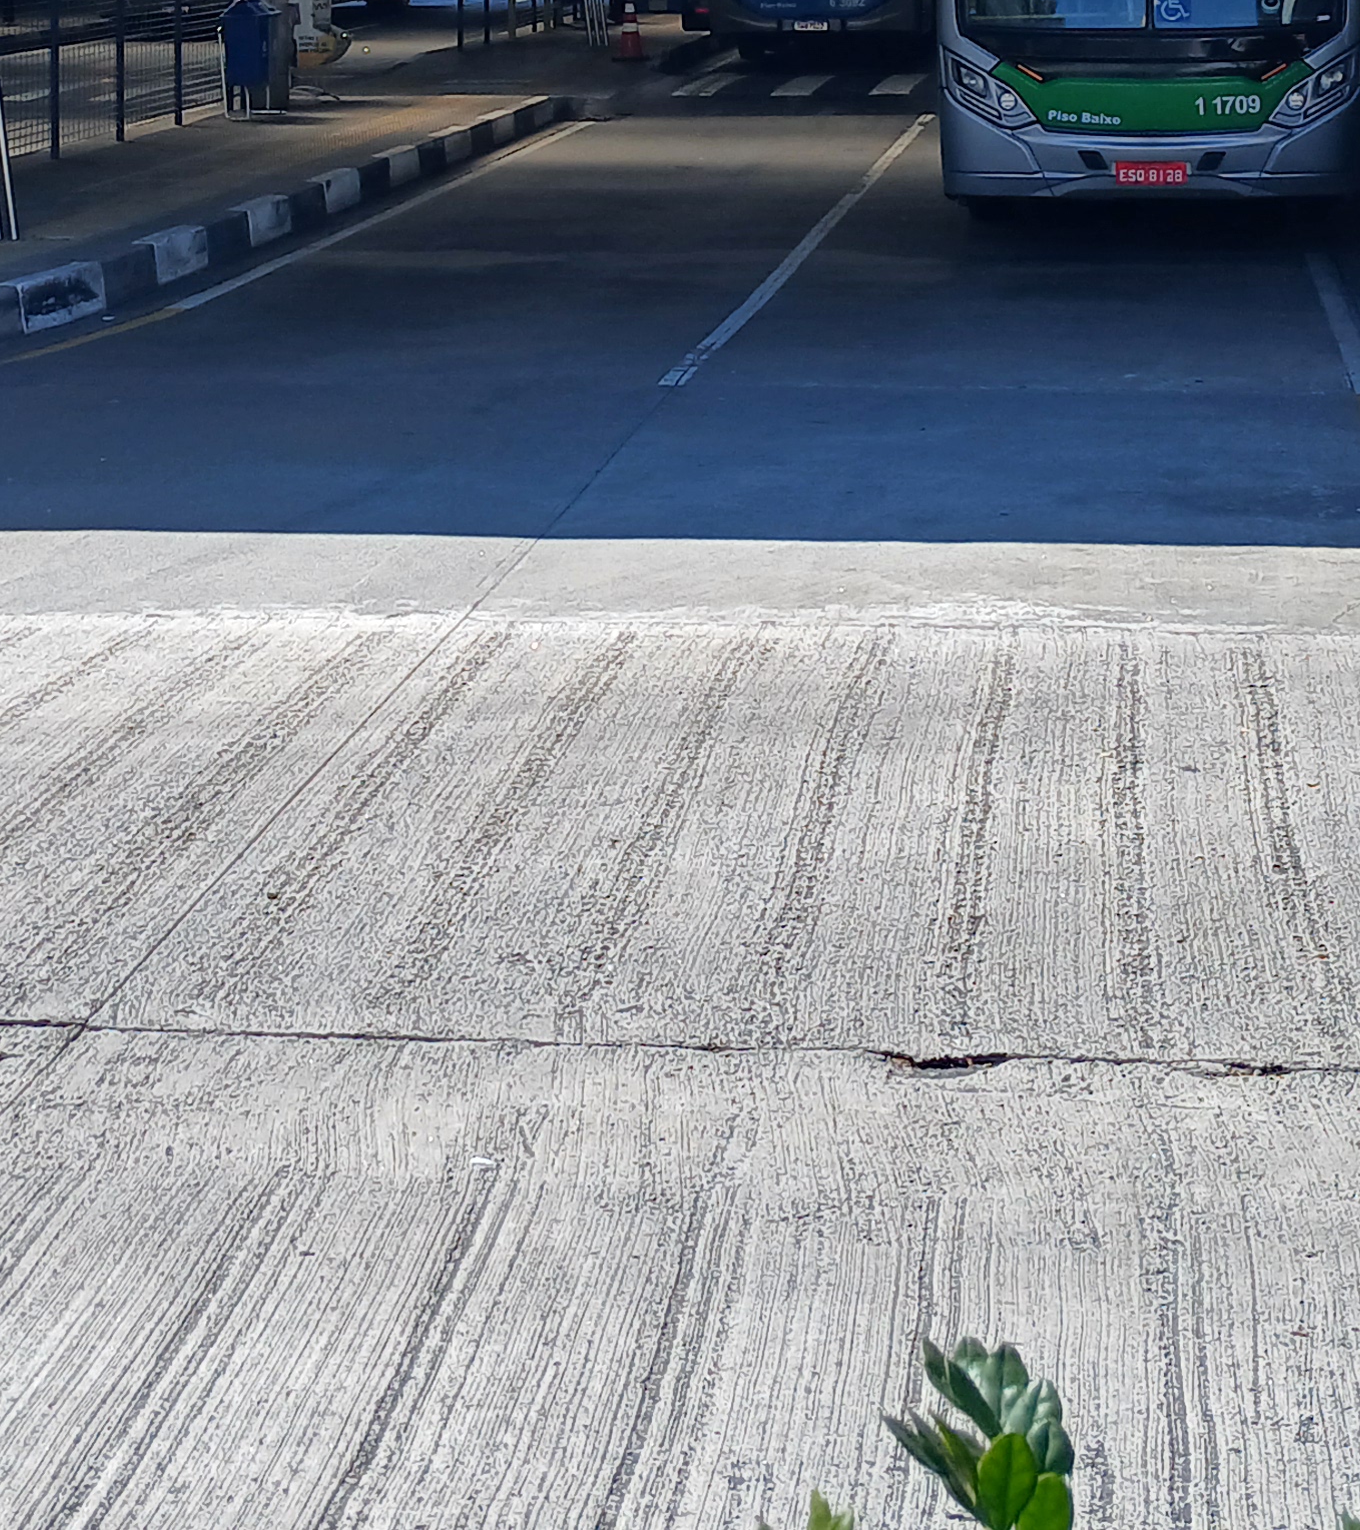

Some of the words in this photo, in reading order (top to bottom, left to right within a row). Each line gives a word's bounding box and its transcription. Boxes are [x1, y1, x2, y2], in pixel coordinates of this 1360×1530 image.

[1194, 96, 1206, 116] 1
[1212, 95, 1262, 115] 1709
[1047, 109, 1078, 123] Piso
[1080, 111, 1122, 126] Baixo
